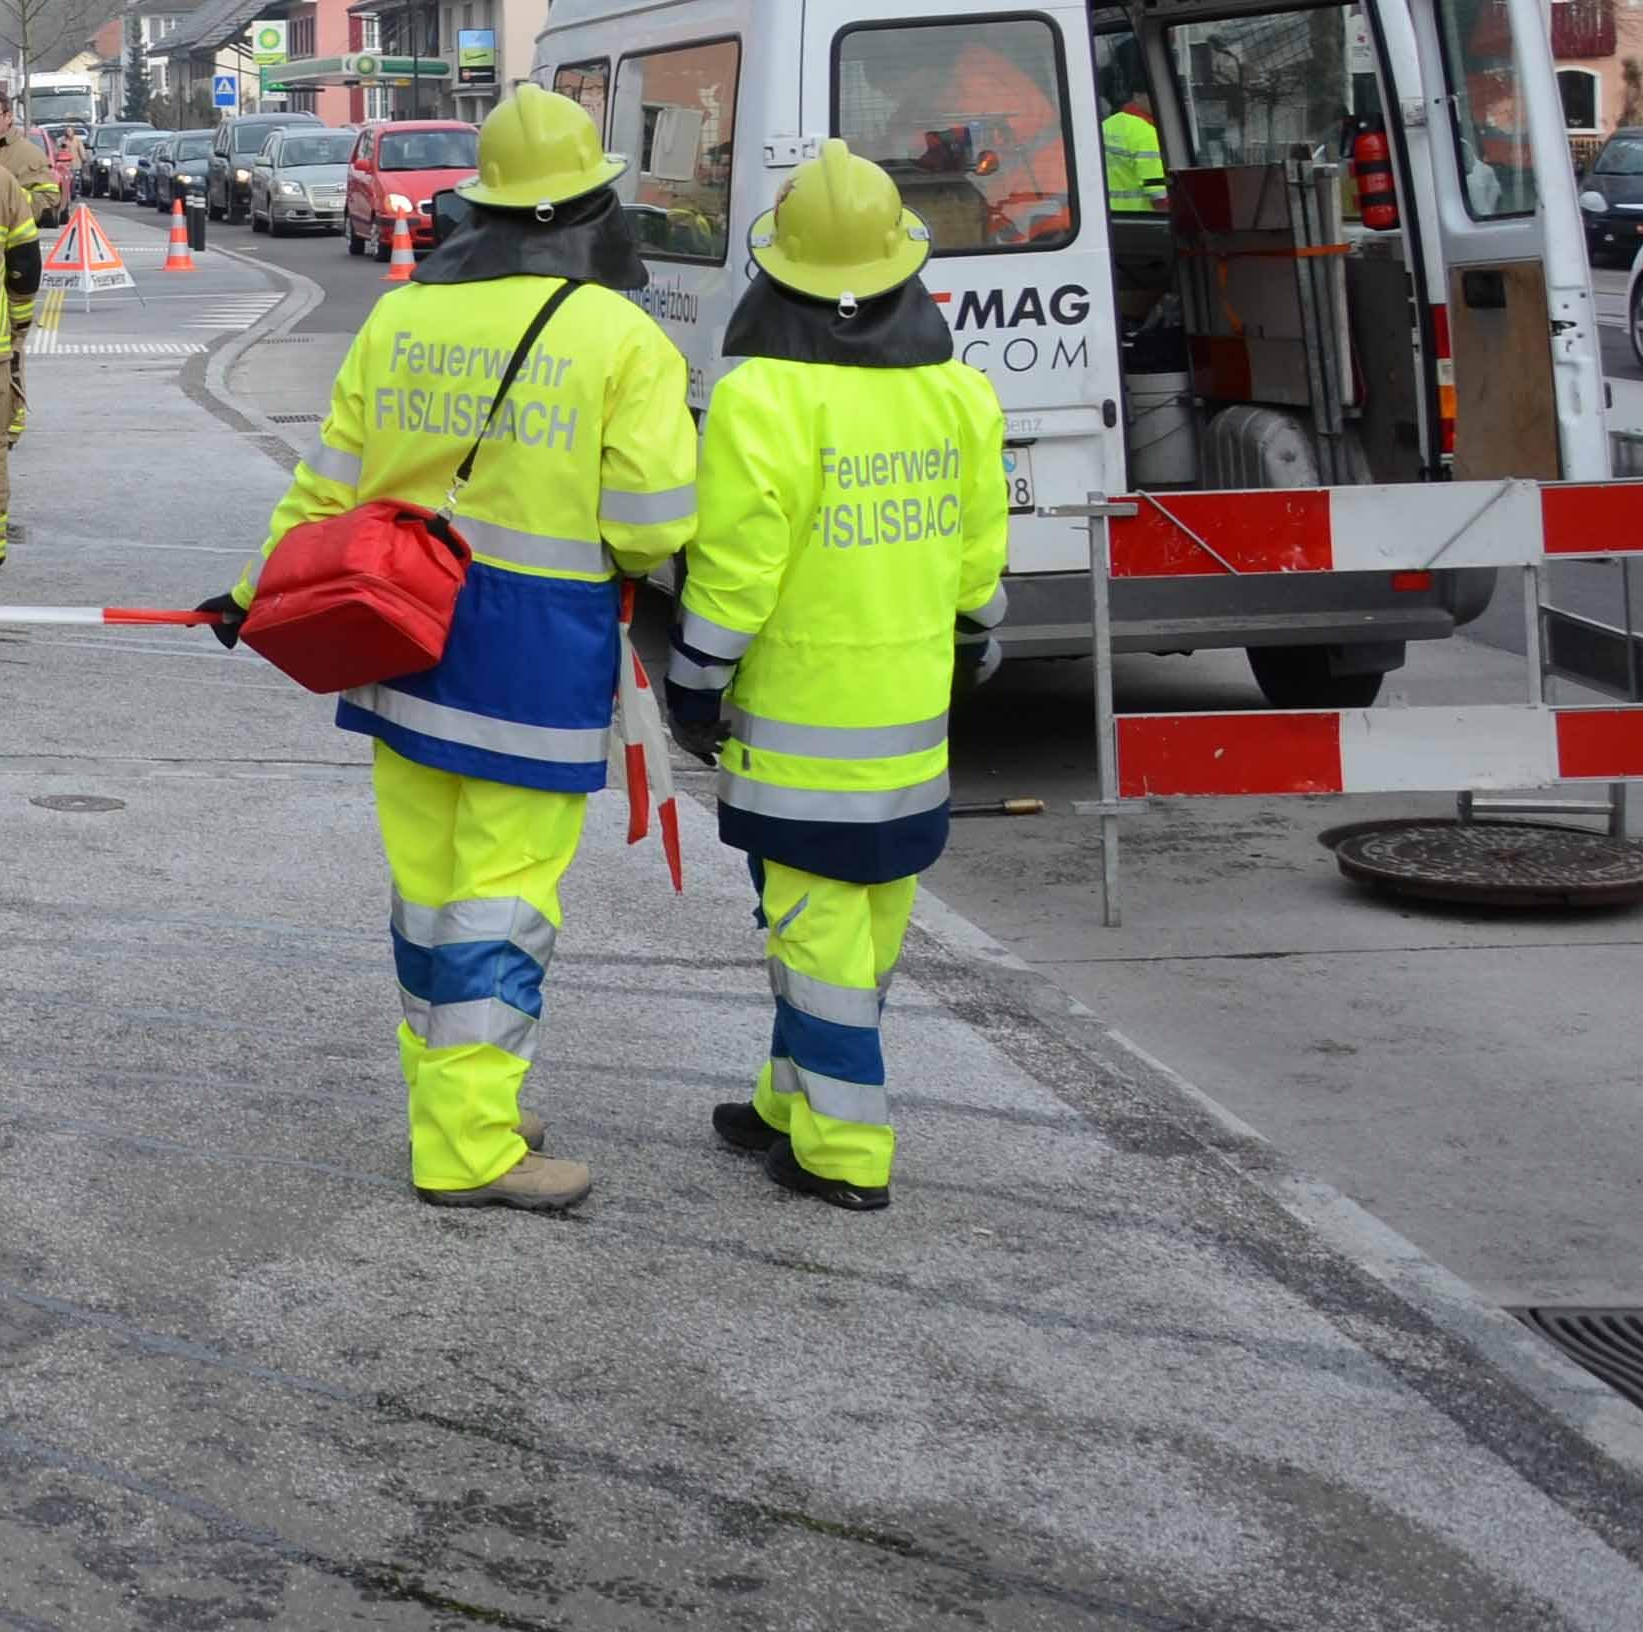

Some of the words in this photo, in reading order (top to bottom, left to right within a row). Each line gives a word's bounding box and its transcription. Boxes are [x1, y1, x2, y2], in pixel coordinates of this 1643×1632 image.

[928, 284, 1091, 331] MAG
[688, 368, 705, 400] en
[375, 386, 580, 452] FISLISBACH
